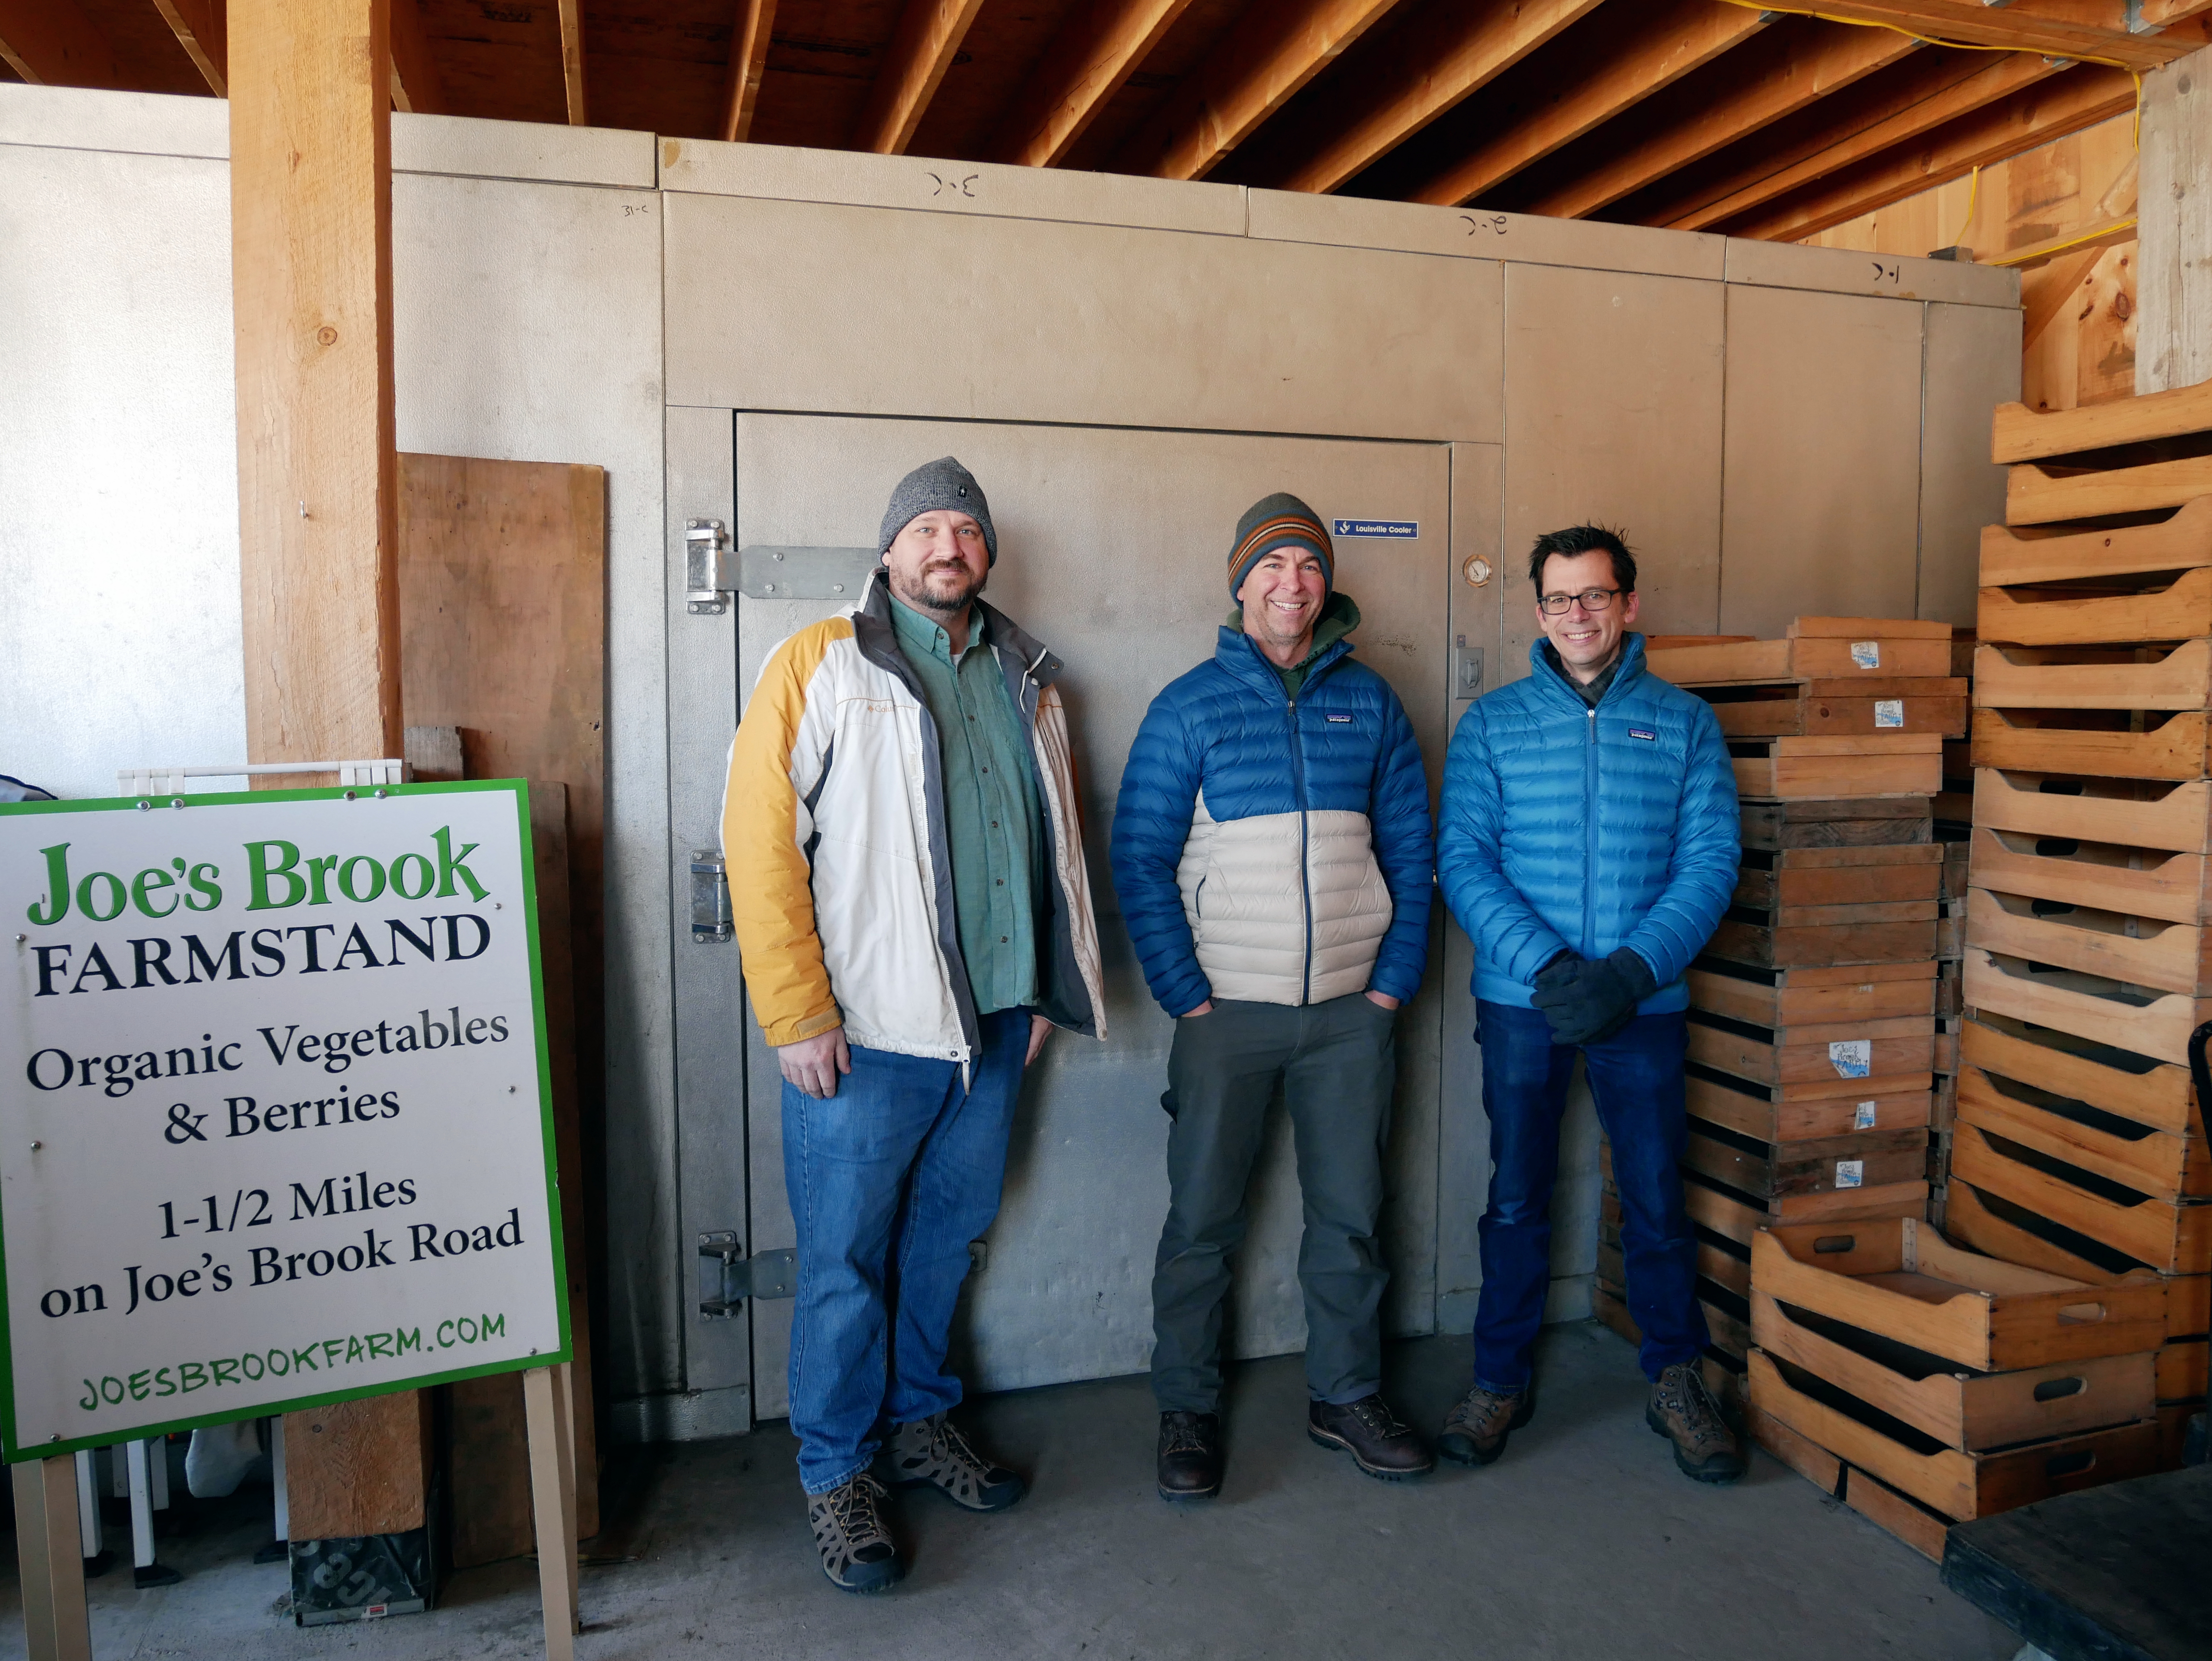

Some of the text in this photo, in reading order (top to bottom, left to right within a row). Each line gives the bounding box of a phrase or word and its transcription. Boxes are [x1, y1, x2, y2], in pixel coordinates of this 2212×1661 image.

[1356, 525, 1387, 533] Louisville
[26, 826, 491, 926] Joe's Brook
[30, 914, 491, 997] FARMSTAND
[26, 1006, 509, 1098] Organic Vegetables
[164, 1085, 400, 1145] & Berries
[158, 1171, 417, 1239] 1-1/2 Miles
[40, 1207, 525, 1318] on Joe's Brook Road
[78, 1313, 506, 1411] JOESBROOKFARM.COM
